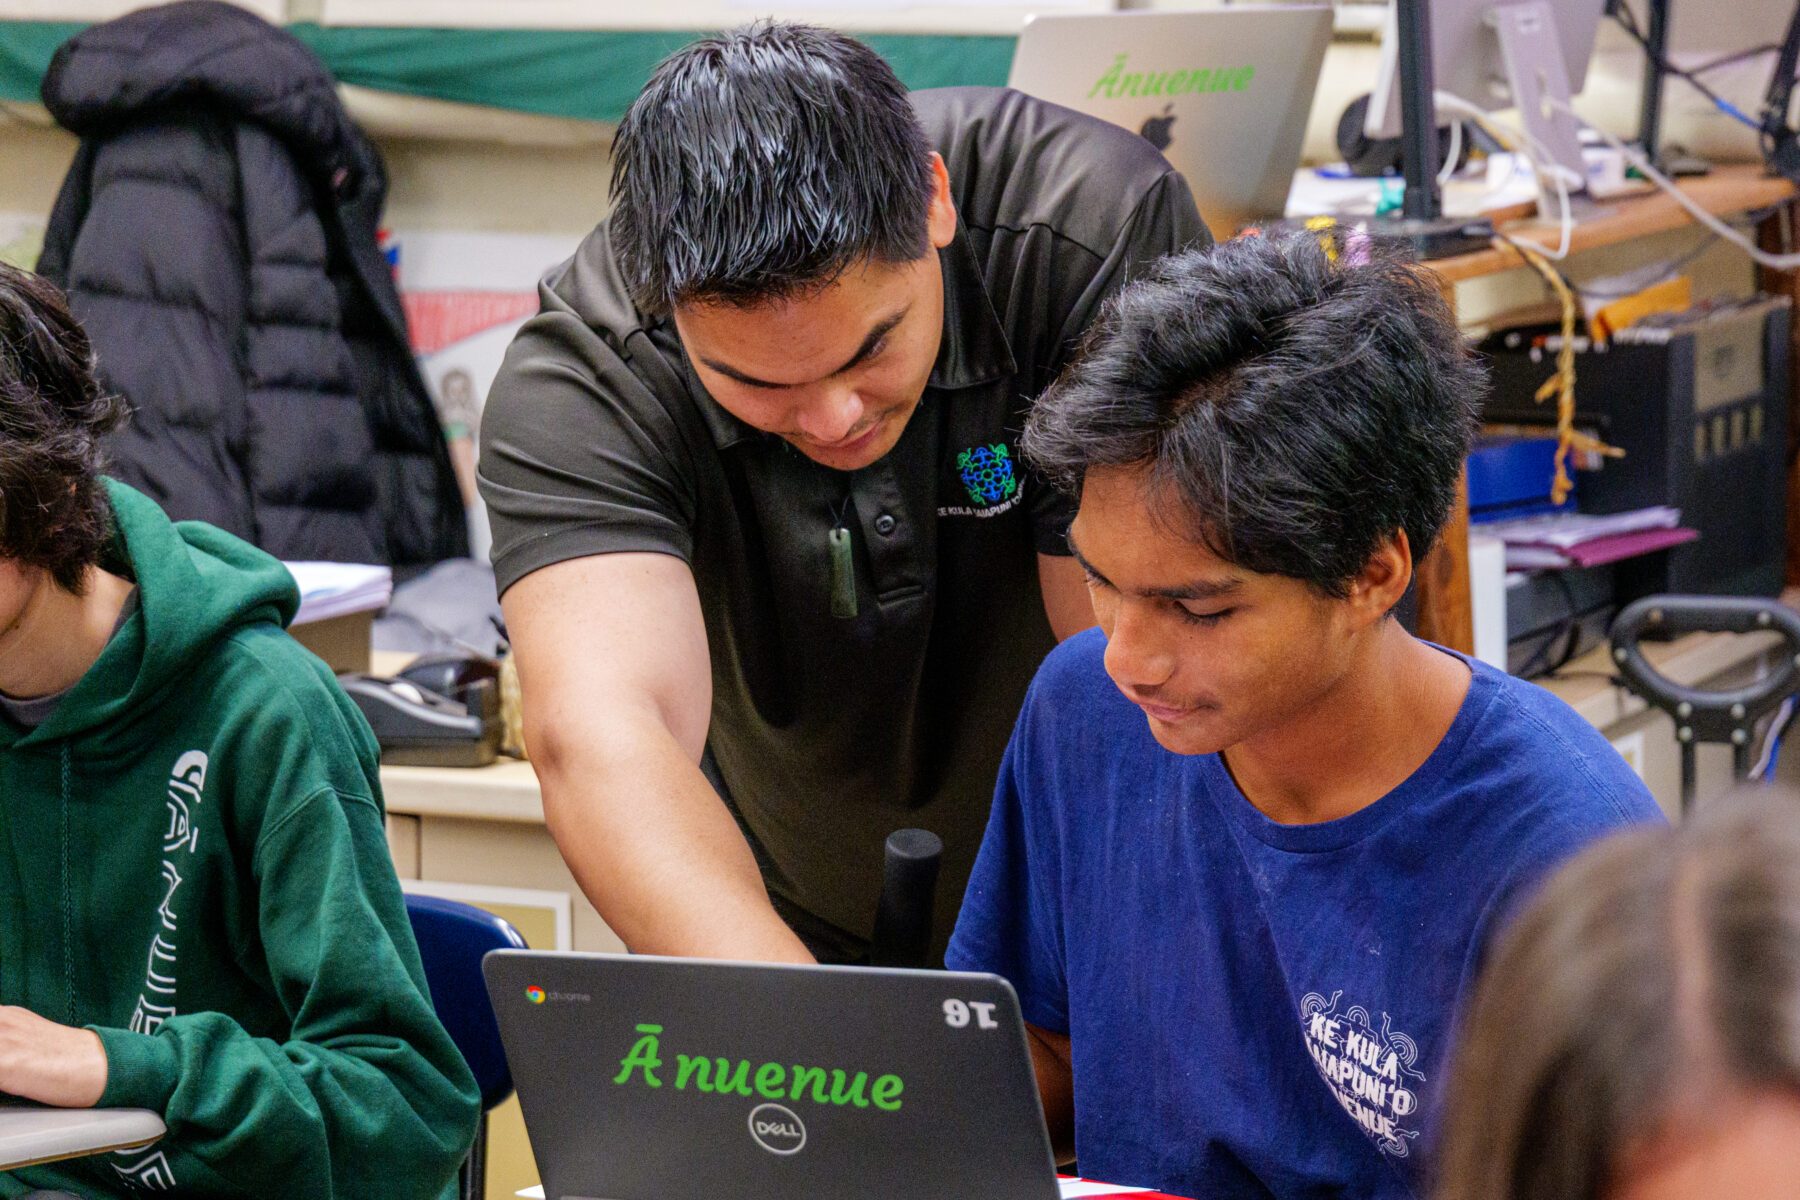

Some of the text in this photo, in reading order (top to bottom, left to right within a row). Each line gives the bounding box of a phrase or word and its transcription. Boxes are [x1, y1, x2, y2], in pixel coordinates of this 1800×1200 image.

[1087, 53, 1256, 99] Ānuenue
[1310, 1011, 1399, 1080] KE KULA
[756, 1121, 801, 1137] DELL
